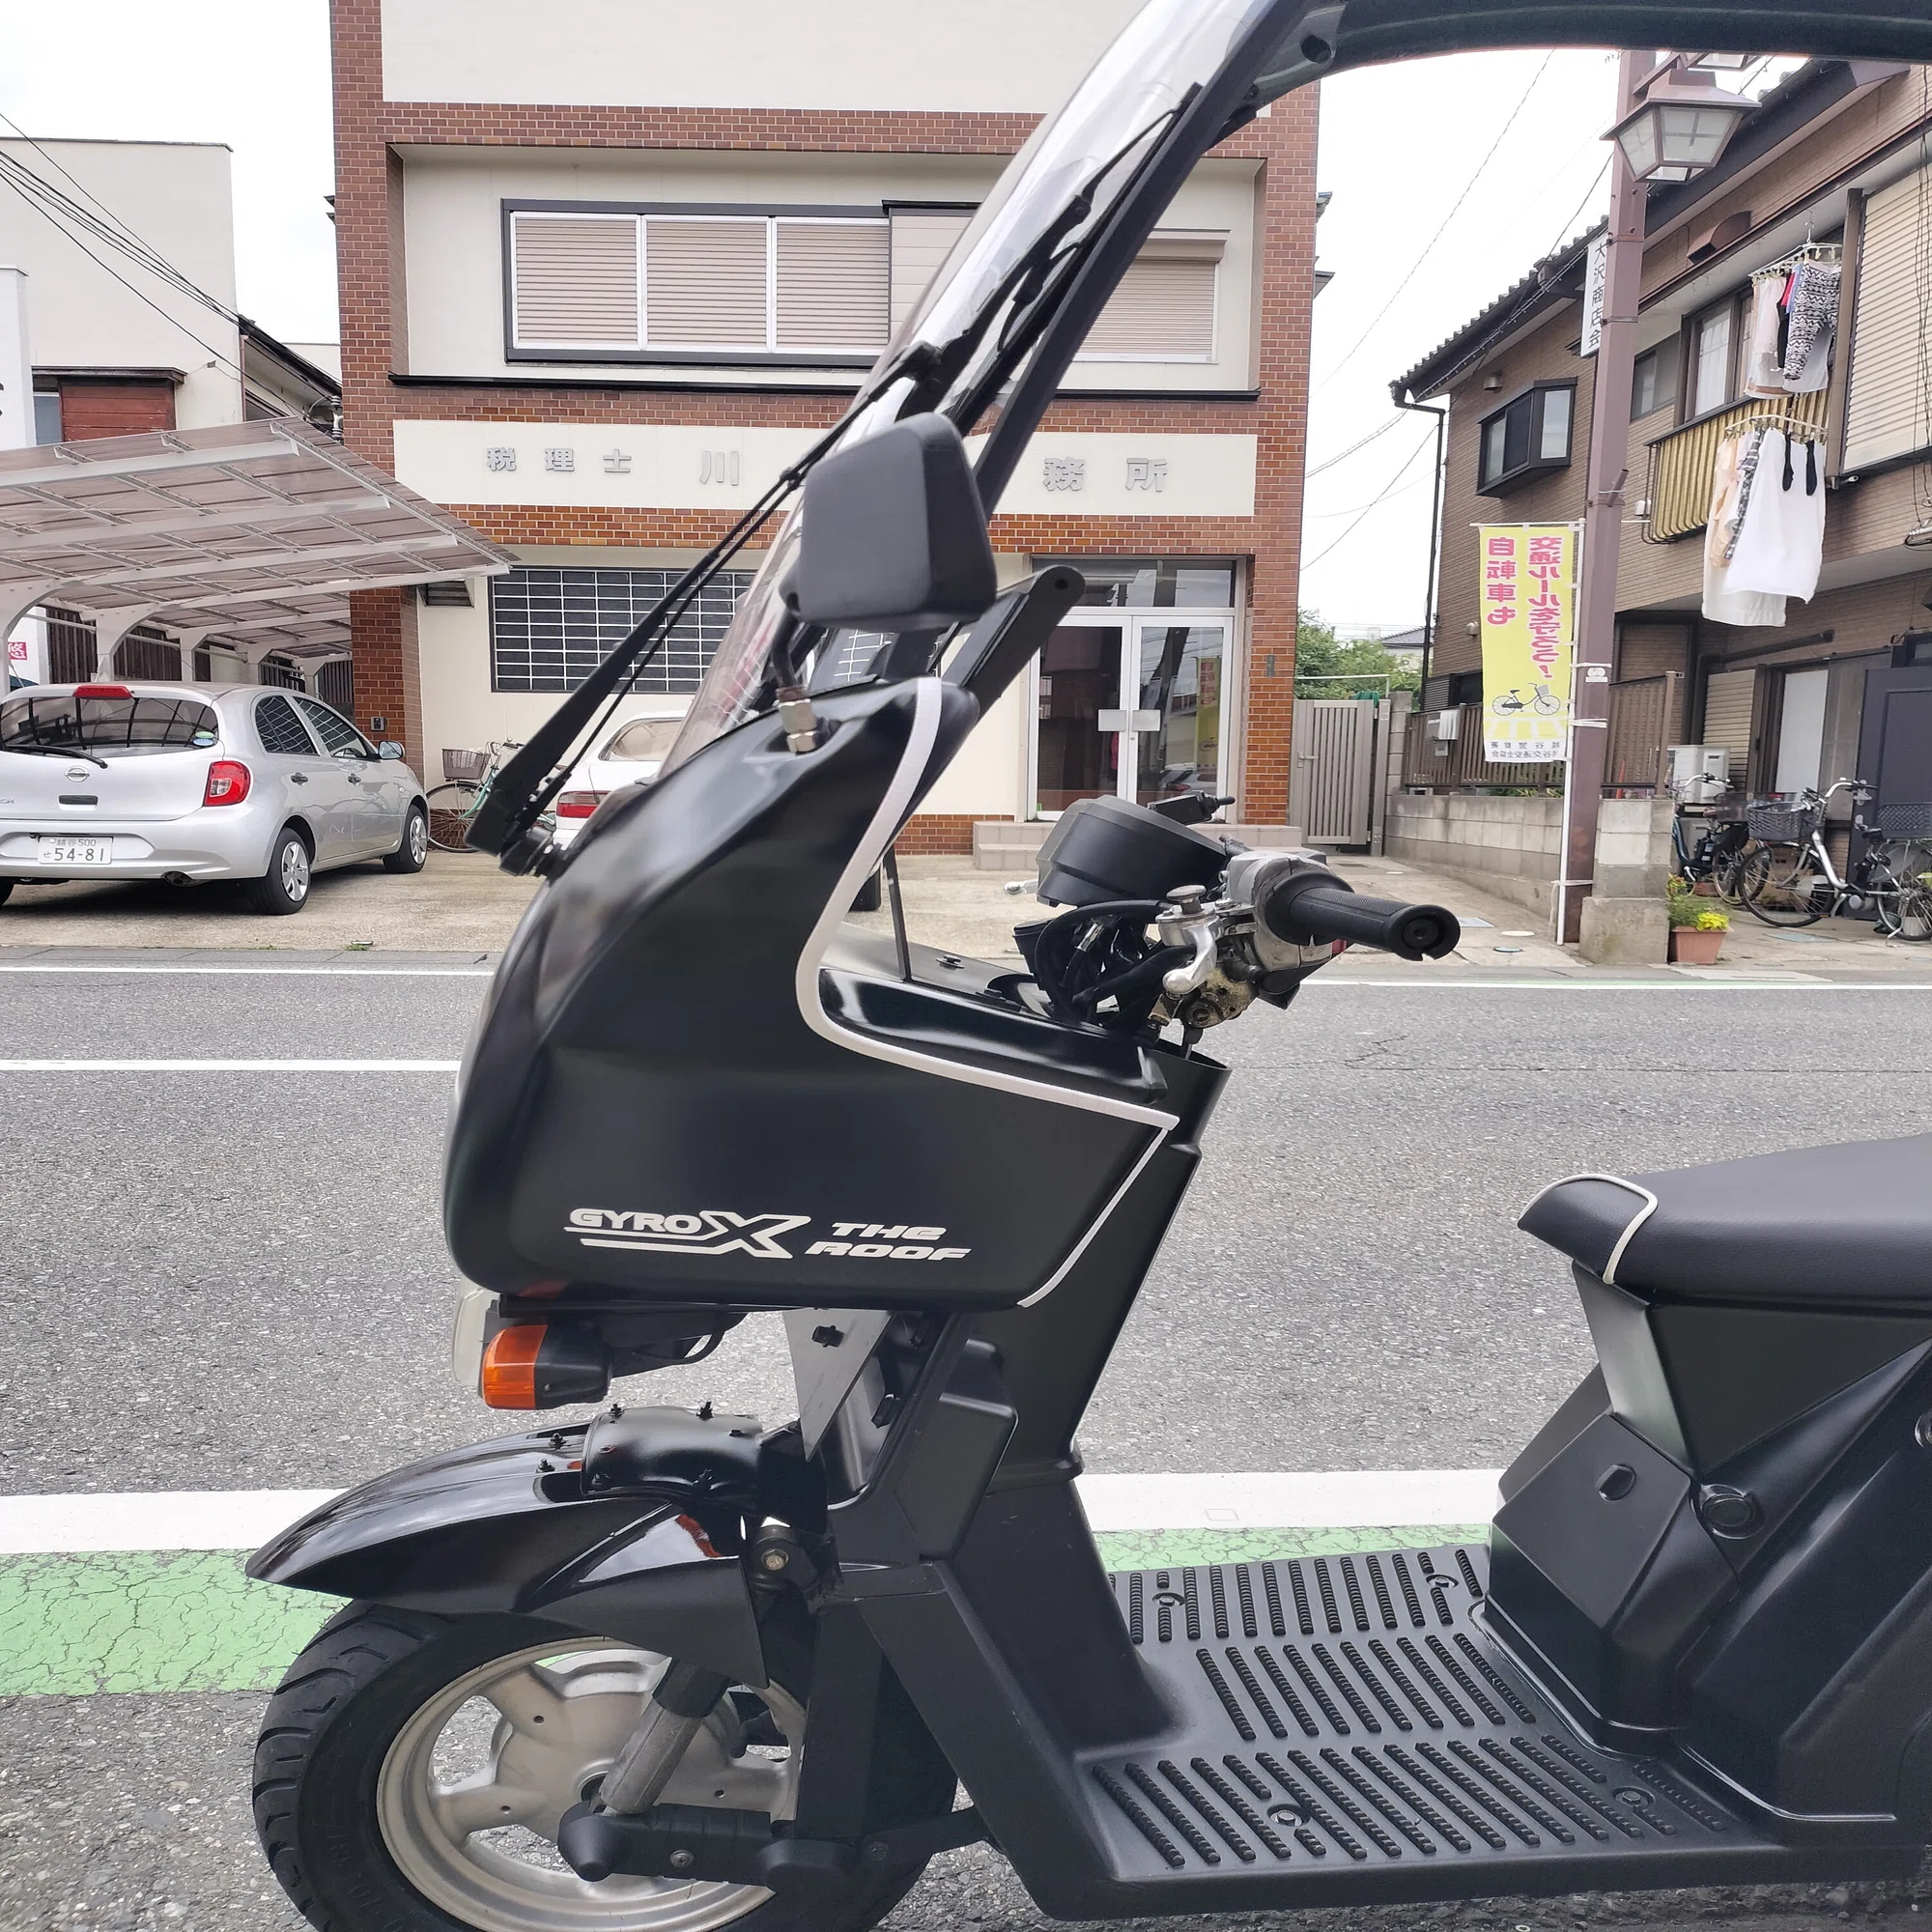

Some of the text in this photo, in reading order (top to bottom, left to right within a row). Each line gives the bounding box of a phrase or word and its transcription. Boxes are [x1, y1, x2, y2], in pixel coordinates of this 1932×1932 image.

[1589, 242, 1606, 349] 大沢商店会
[486, 447, 632, 472] 税理士
[54, 848, 104, 861] 54-81
[831, 1222, 947, 1240] THE
[805, 1240, 972, 1261] ROOF
